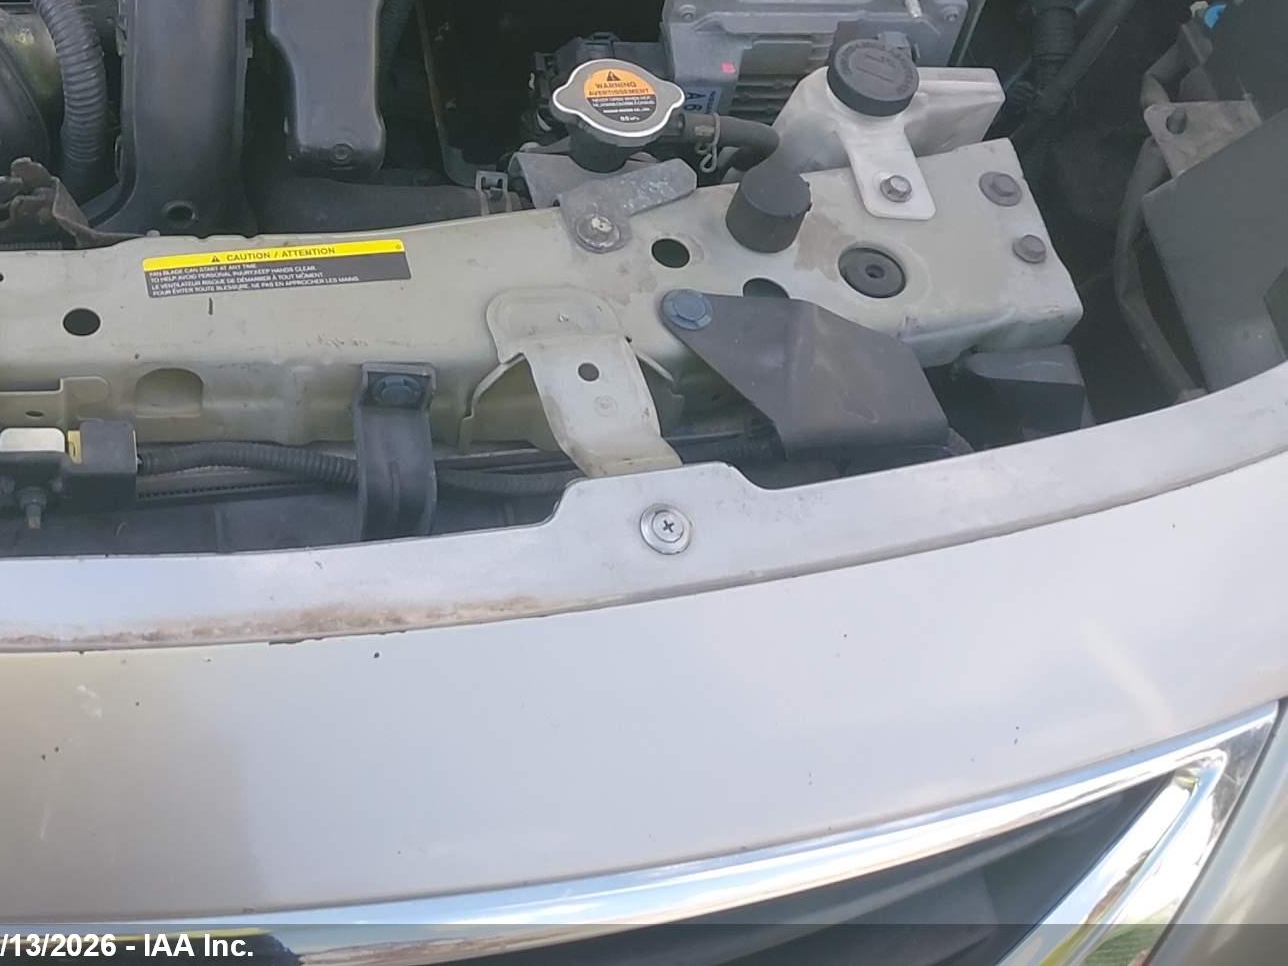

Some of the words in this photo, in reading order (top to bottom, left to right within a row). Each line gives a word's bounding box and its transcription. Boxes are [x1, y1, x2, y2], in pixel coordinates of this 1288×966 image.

[595, 81, 637, 89] WARNING
[226, 251, 270, 261] CAUTION
[281, 247, 335, 258] ATTENTION
